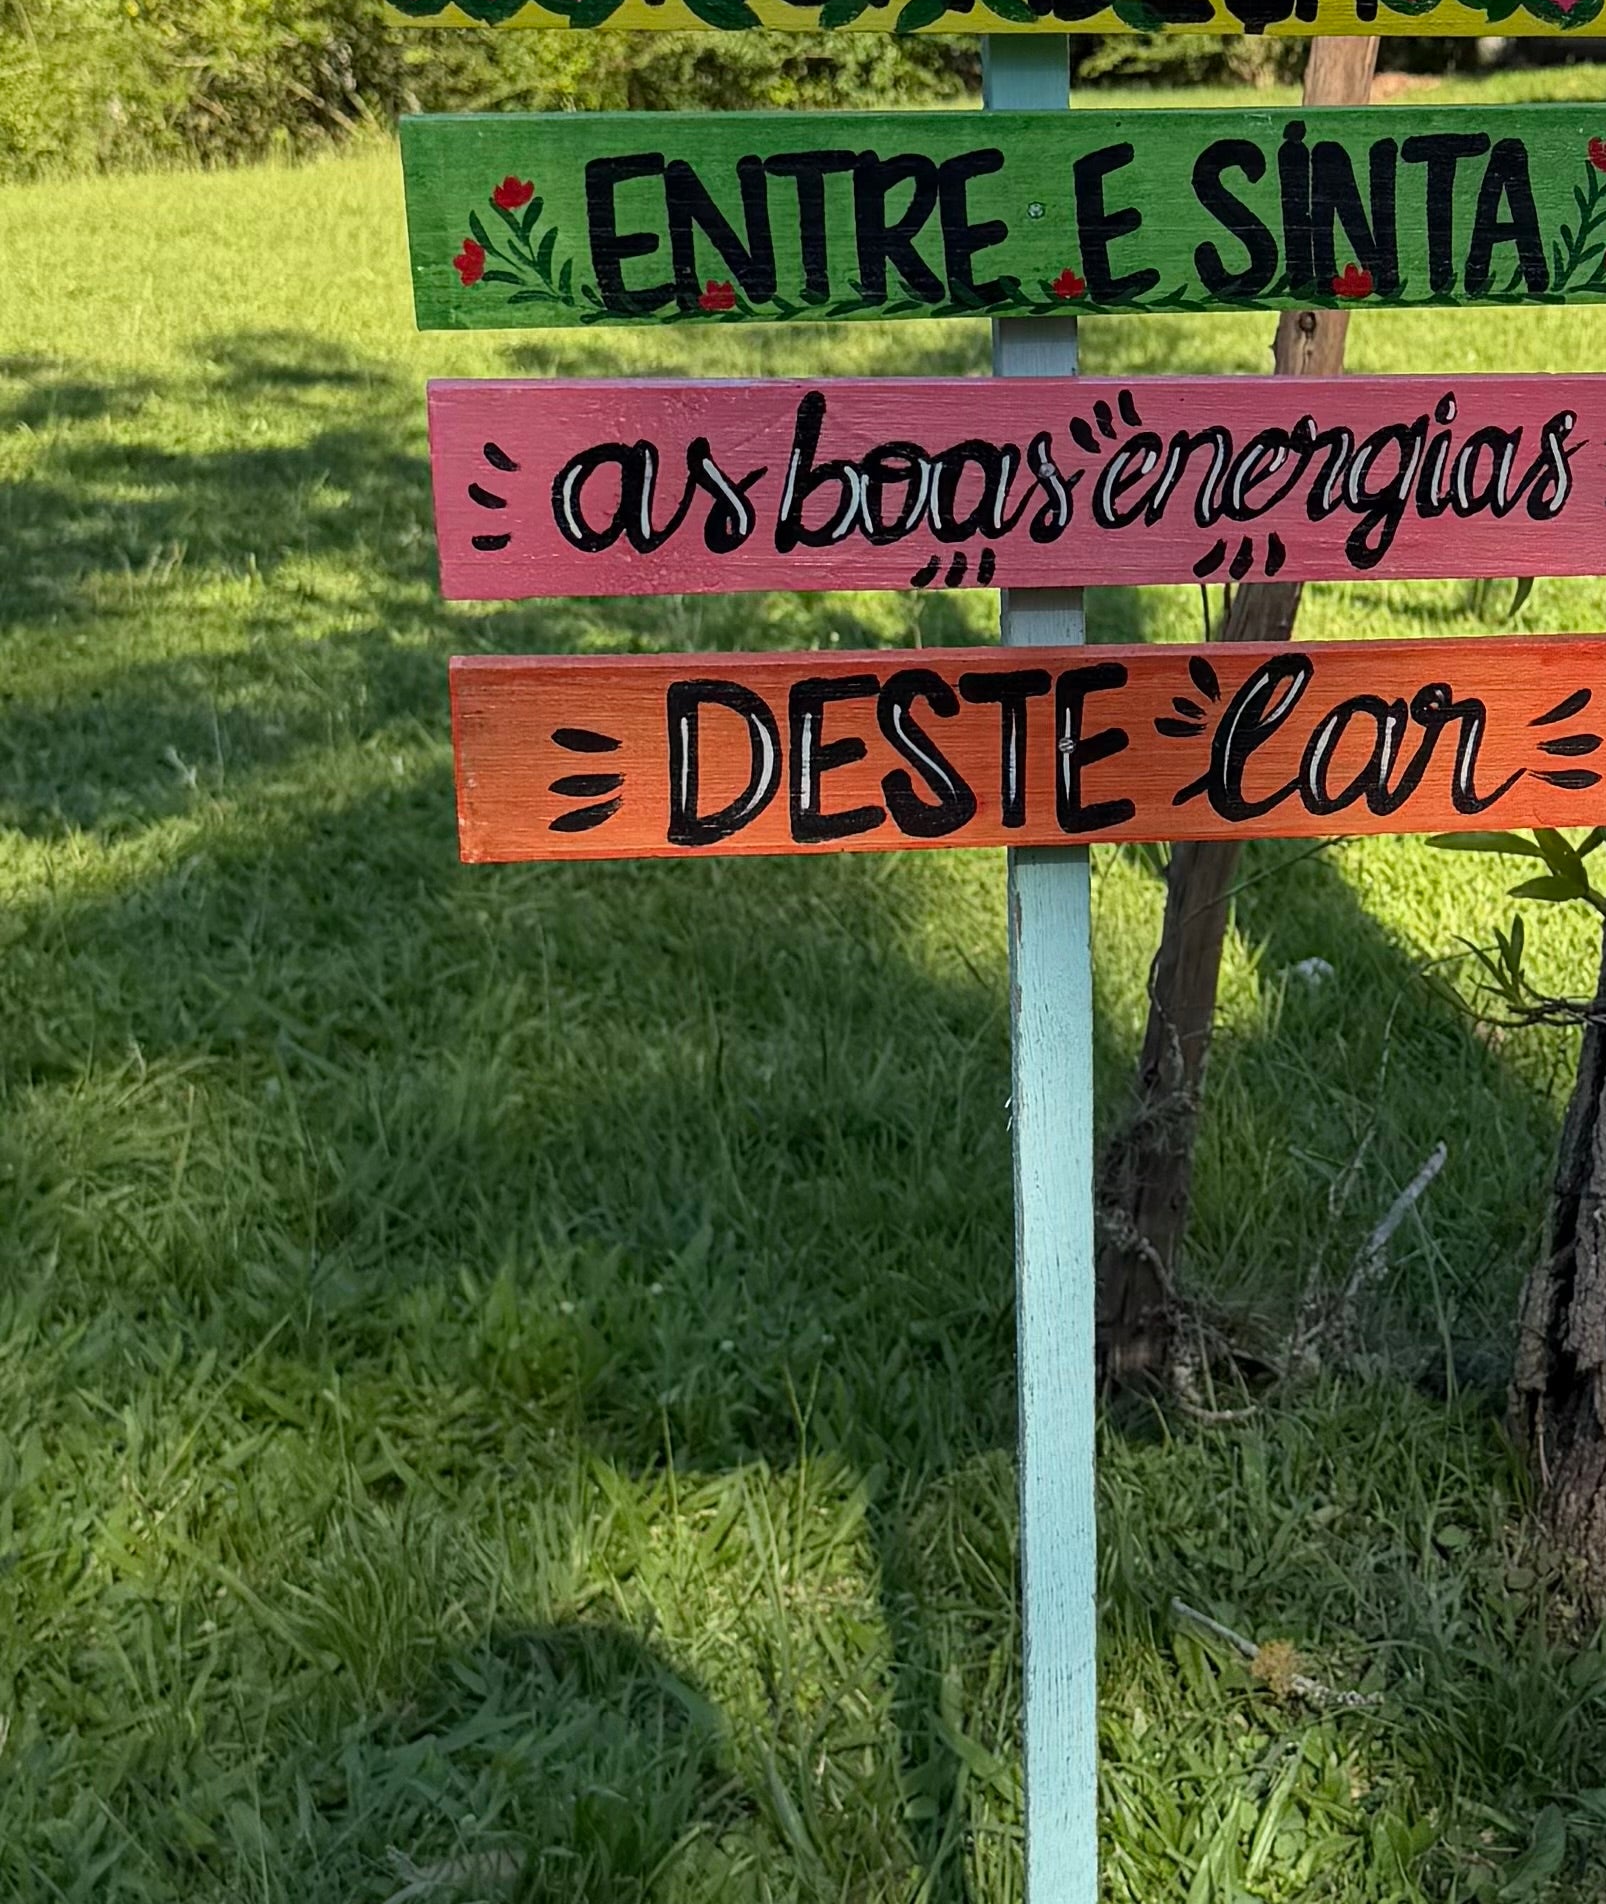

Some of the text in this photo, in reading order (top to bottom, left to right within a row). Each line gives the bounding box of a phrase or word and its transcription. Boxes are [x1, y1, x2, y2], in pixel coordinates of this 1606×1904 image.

[584, 148, 1010, 312] ENTRE
[1073, 142, 1164, 304] E
[552, 391, 1585, 570] as boas energias
[664, 652, 1526, 847] DESTE lar
